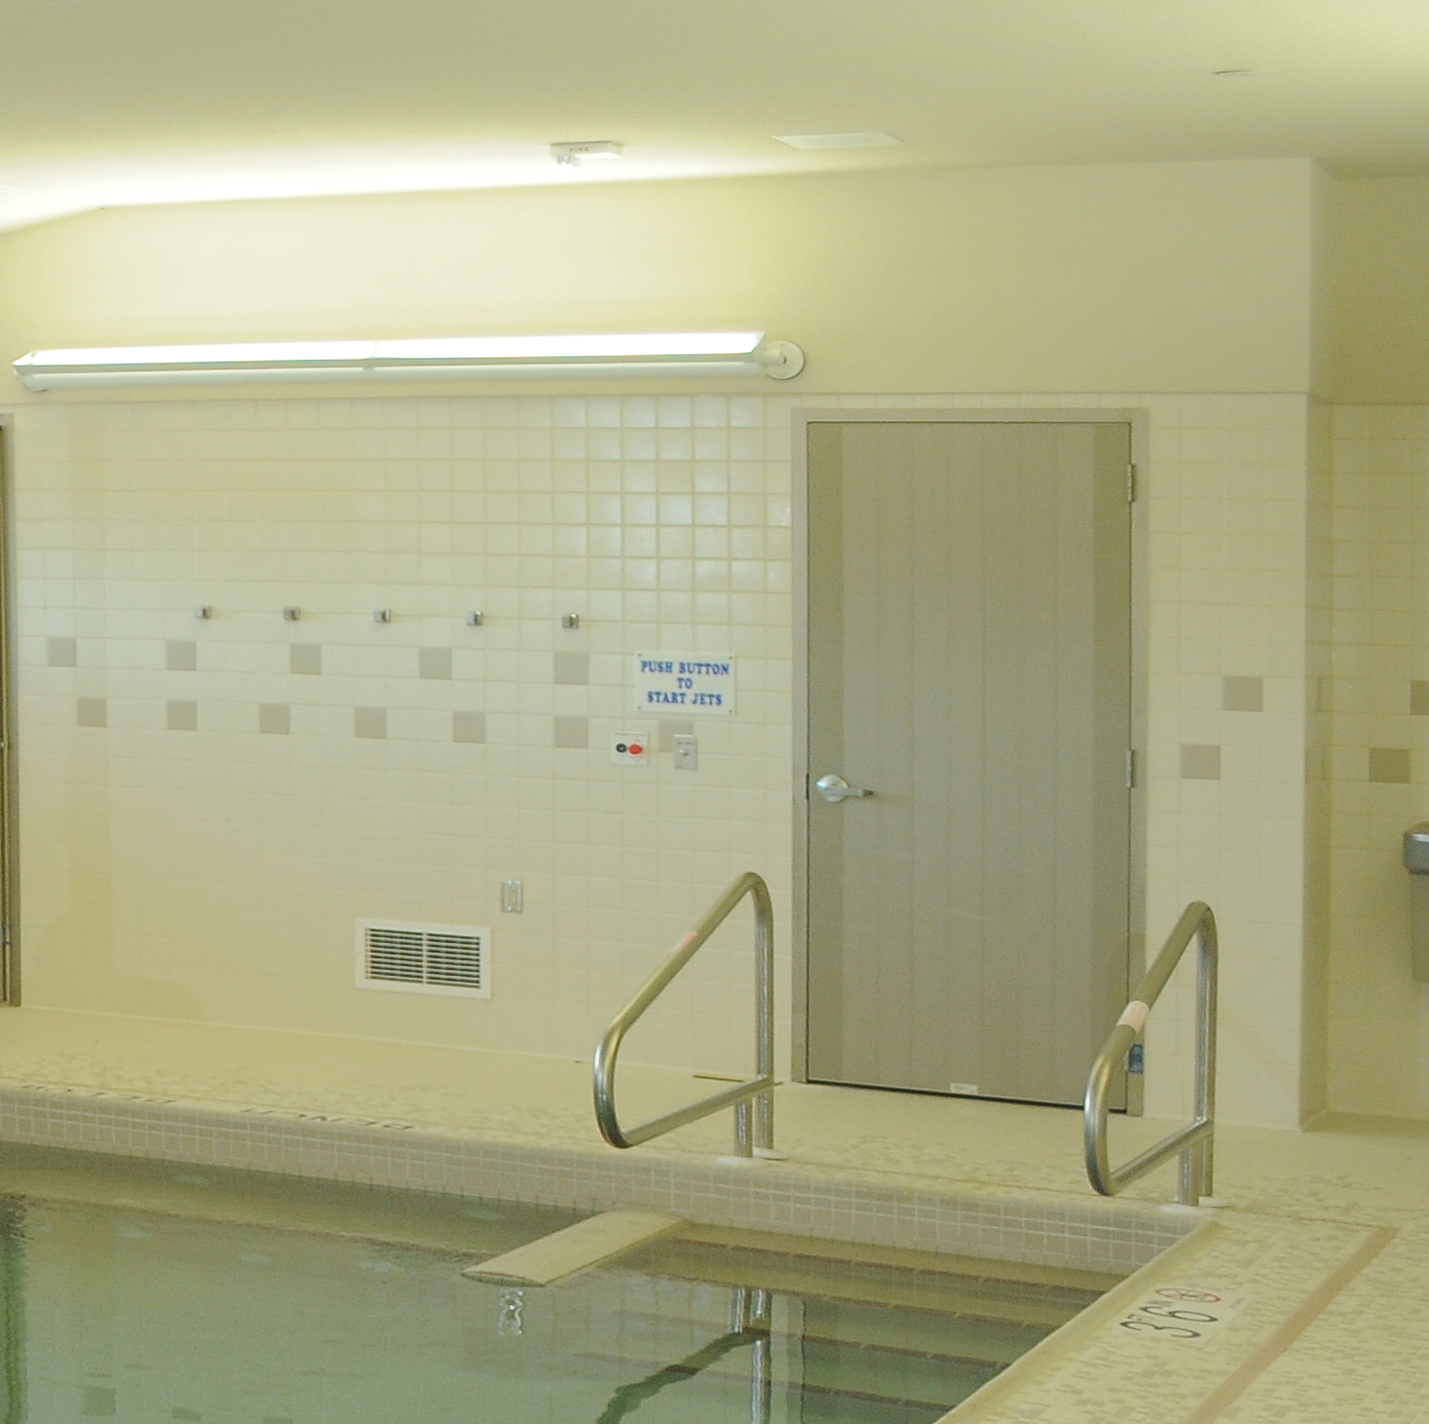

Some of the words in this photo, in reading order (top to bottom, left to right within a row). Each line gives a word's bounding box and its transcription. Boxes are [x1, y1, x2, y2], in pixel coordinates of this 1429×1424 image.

[641, 660, 673, 674] PUSH
[679, 662, 730, 675] BUTTON
[677, 678, 693, 689] TO
[647, 691, 686, 704] START
[691, 694, 723, 706] JETS
[1139, 1306, 1218, 1322] 6
[1119, 1321, 1201, 1338] 3
